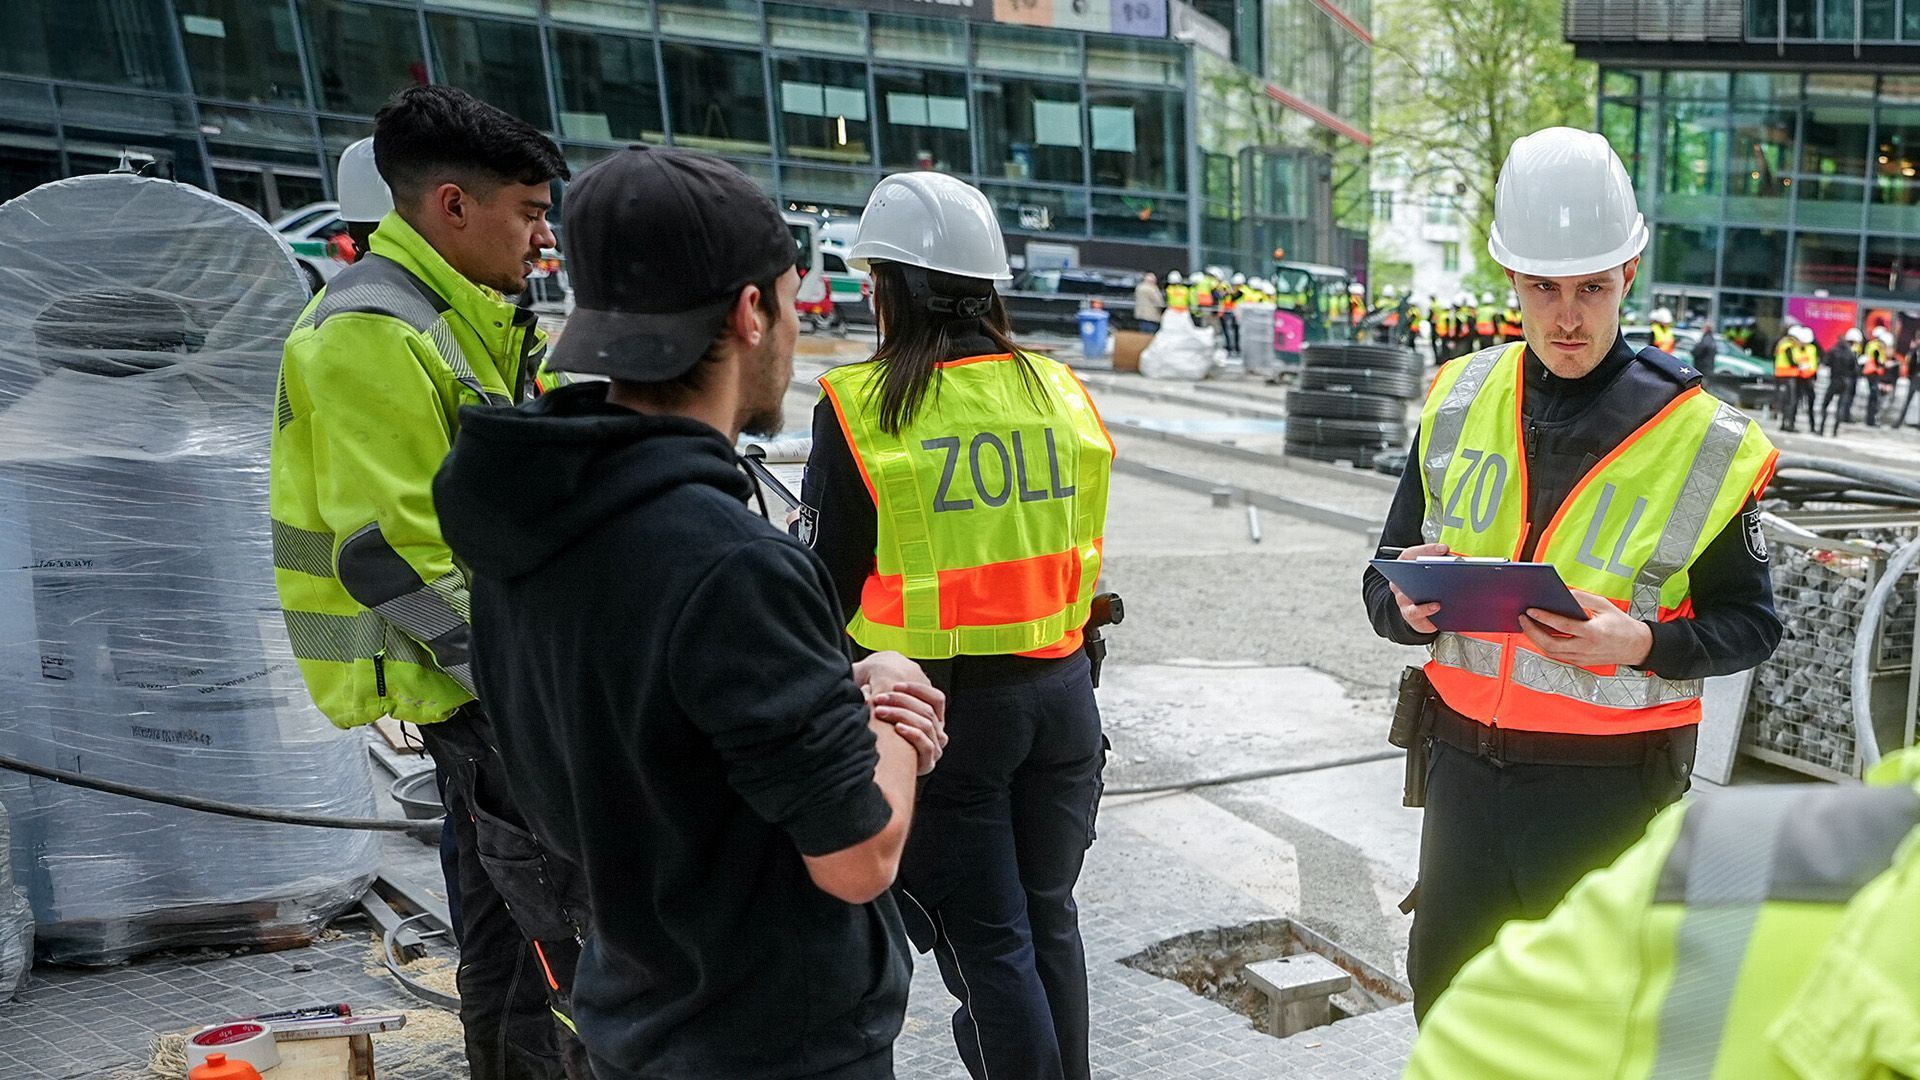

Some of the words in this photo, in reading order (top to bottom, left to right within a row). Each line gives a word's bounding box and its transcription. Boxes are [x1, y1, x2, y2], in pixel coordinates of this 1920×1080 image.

[920, 428, 1076, 512] ZOLL
[800, 504, 812, 518] OLL
[1749, 513, 1760, 523] ZO
